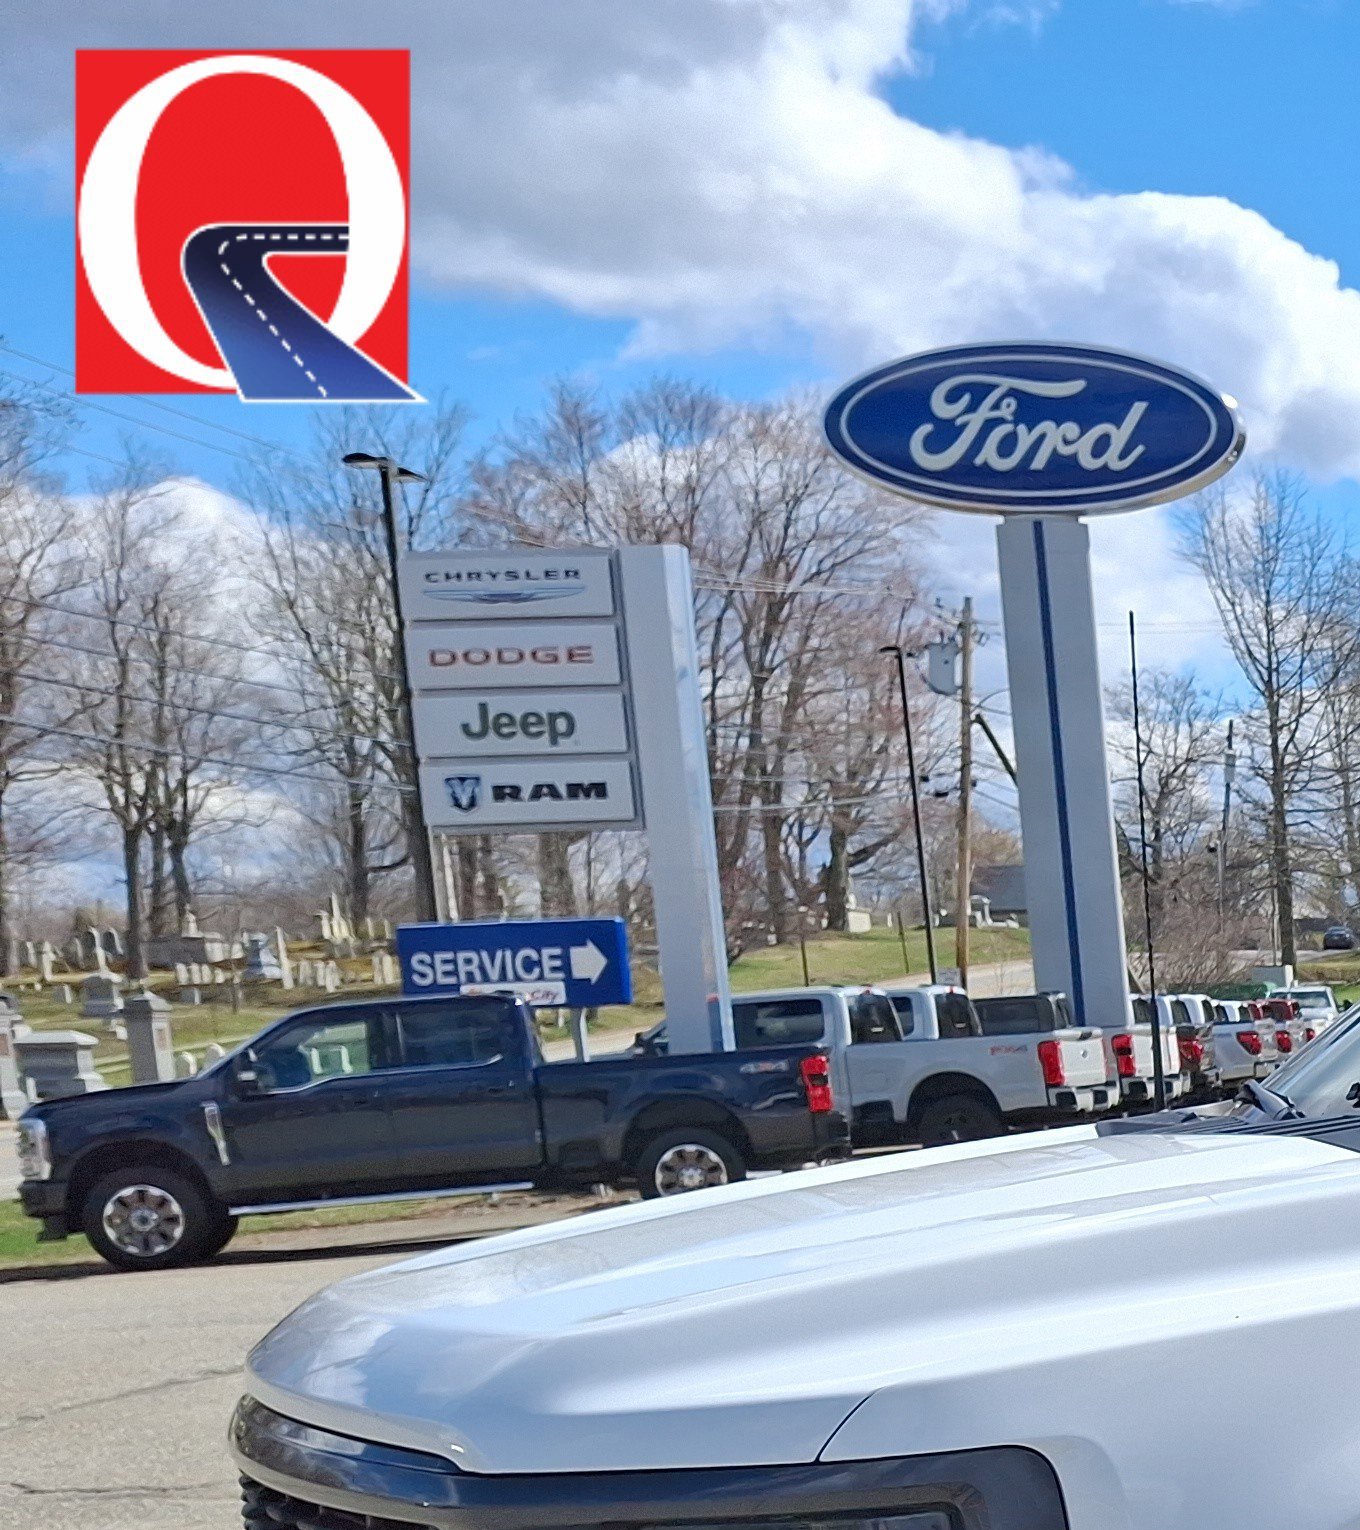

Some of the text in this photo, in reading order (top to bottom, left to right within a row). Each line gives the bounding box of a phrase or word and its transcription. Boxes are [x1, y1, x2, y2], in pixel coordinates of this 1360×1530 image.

[909, 373, 1149, 472] Ford
[424, 568, 581, 583] CHRYSLER
[428, 645, 594, 667] DODGE
[460, 702, 576, 746] Jeep
[491, 781, 608, 803] RAM
[410, 946, 567, 987] SERVICE
